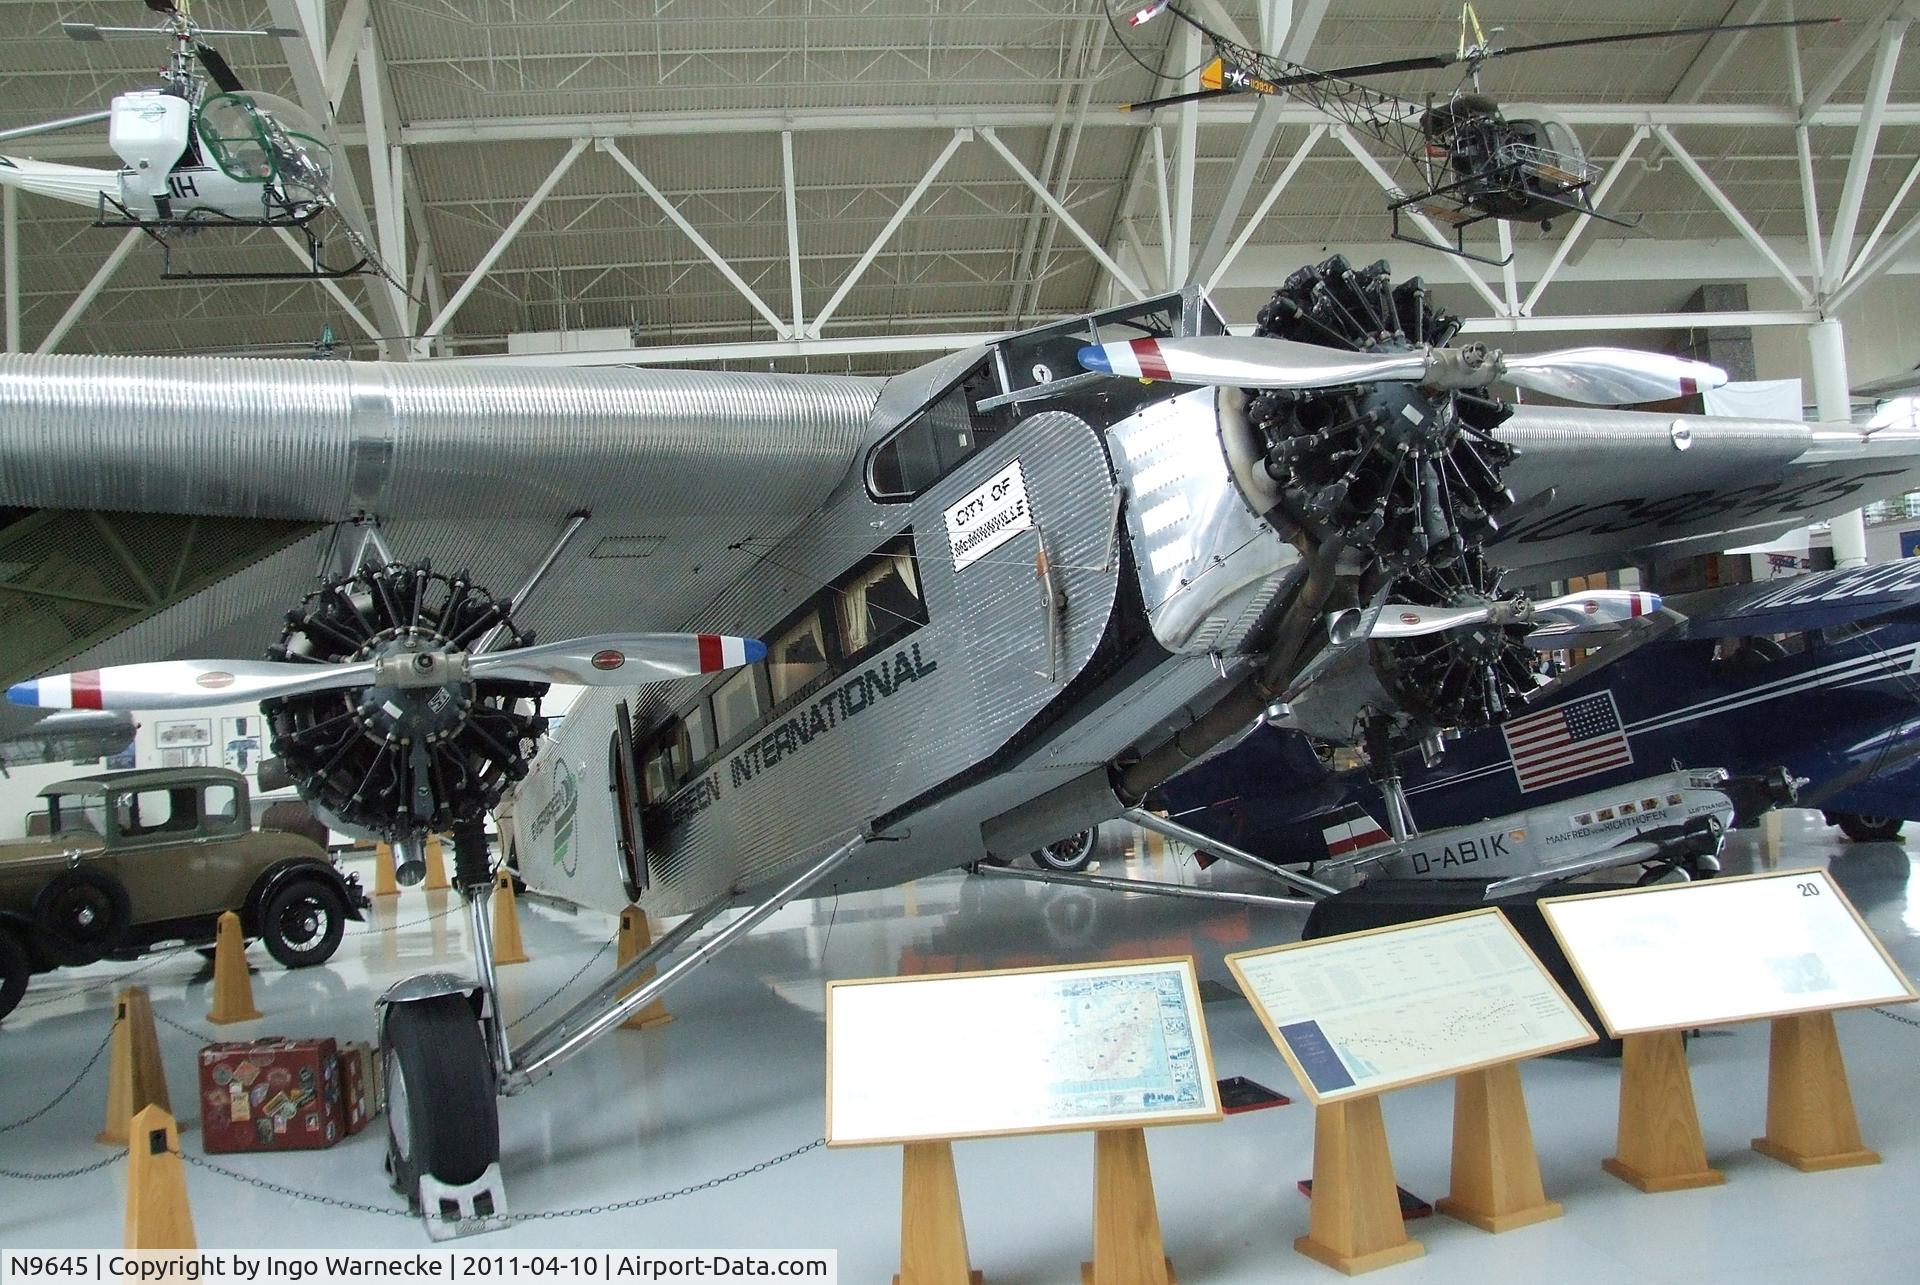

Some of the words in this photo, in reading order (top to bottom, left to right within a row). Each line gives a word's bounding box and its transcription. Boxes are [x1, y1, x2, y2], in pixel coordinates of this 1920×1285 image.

[956, 494, 985, 526] CITY
[991, 477, 1010, 501] OF
[729, 642, 938, 789] INTERNATIONAL
[1412, 833, 1510, 874] D-ABIK
[1545, 817, 1591, 845] MANFRED
[1604, 800, 1668, 833] RICHTHOFEN
[1797, 882, 1820, 897] 20
